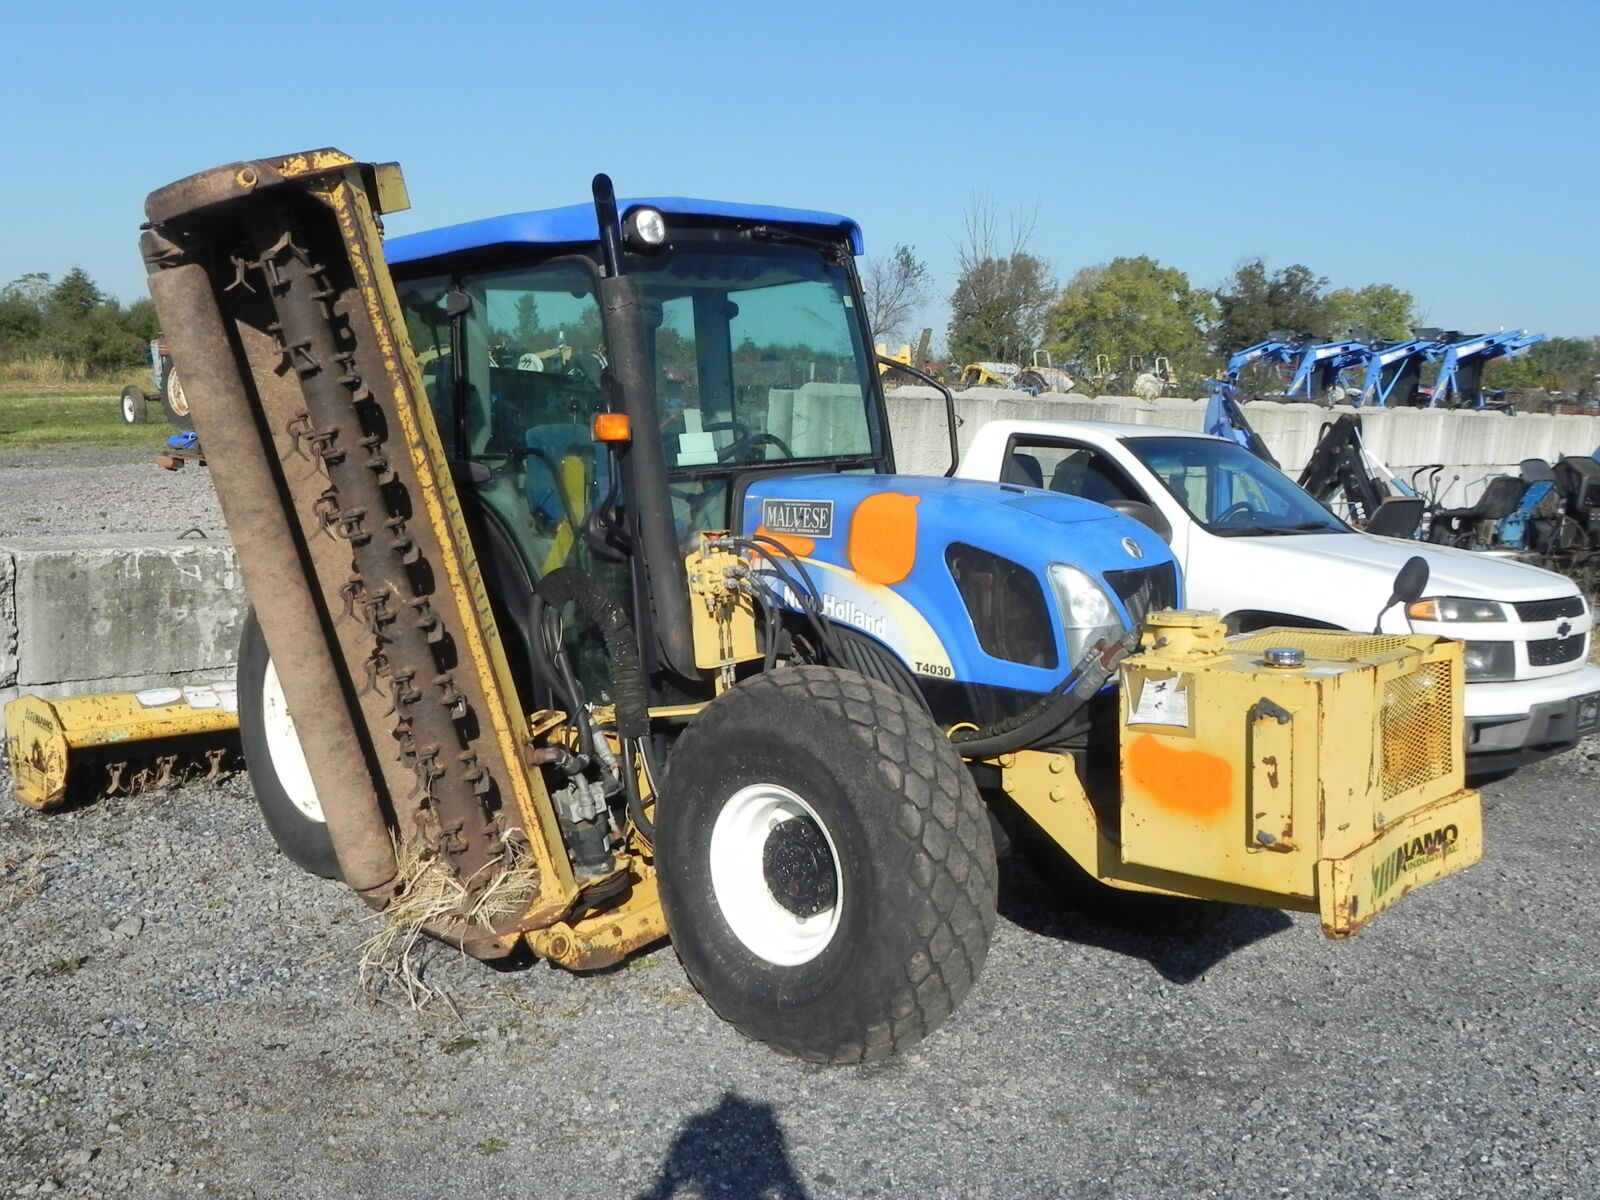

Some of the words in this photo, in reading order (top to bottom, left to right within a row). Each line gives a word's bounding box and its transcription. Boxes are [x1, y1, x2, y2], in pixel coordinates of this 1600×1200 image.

[766, 506, 829, 529] MALVESE
[822, 592, 887, 639] Holland
[915, 661, 951, 677] T4030
[1396, 824, 1458, 874] ALAMO
